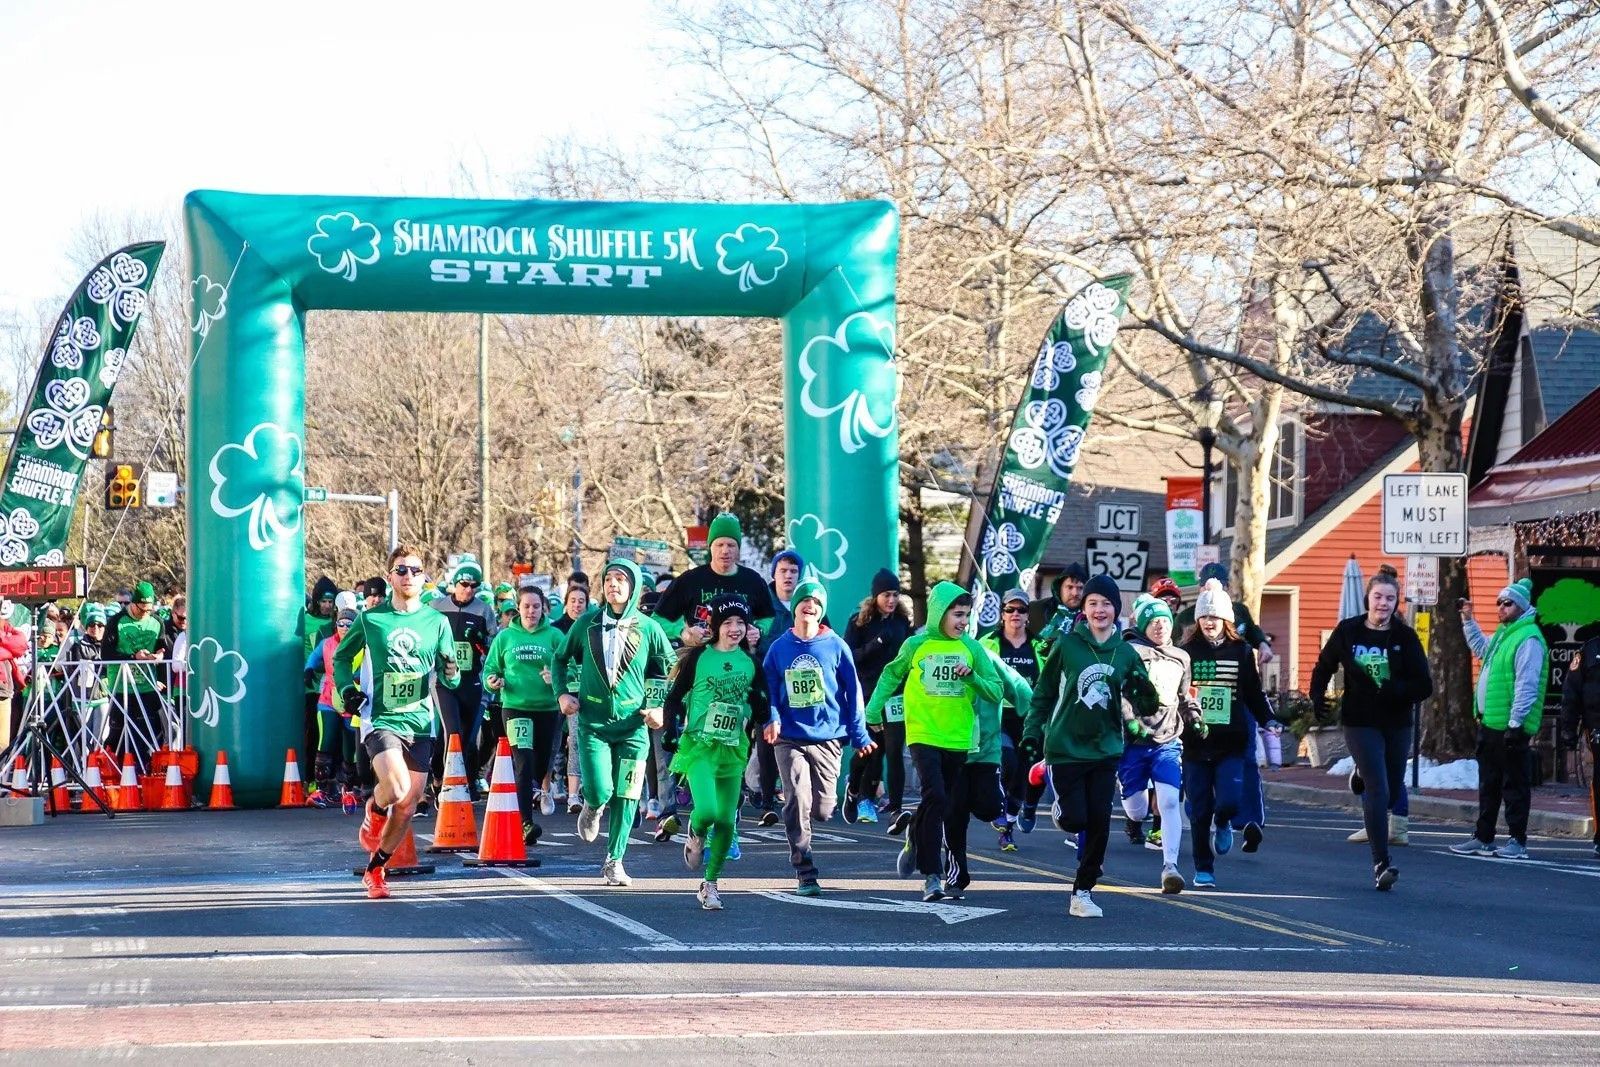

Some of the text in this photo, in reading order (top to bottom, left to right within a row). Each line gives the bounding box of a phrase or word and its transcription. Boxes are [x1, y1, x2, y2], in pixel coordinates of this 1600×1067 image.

[393, 219, 703, 270] SHAMROCK SHUFFLE 5K
[430, 259, 662, 288] START
[20, 454, 62, 469] NEWTOWN
[1390, 485, 1459, 497] LEFT LANE
[1100, 510, 1137, 531] JCT
[1402, 507, 1447, 522] MUST
[1390, 532, 1460, 544] TURN LEFT
[1091, 552, 1142, 580] 532
[390, 683, 415, 698] 129
[646, 687, 665, 700] 220
[792, 679, 817, 694] 682
[890, 704, 904, 716] 65
[1200, 696, 1224, 711] 629
[712, 714, 738, 732] 506
[514, 726, 528, 738] 72
